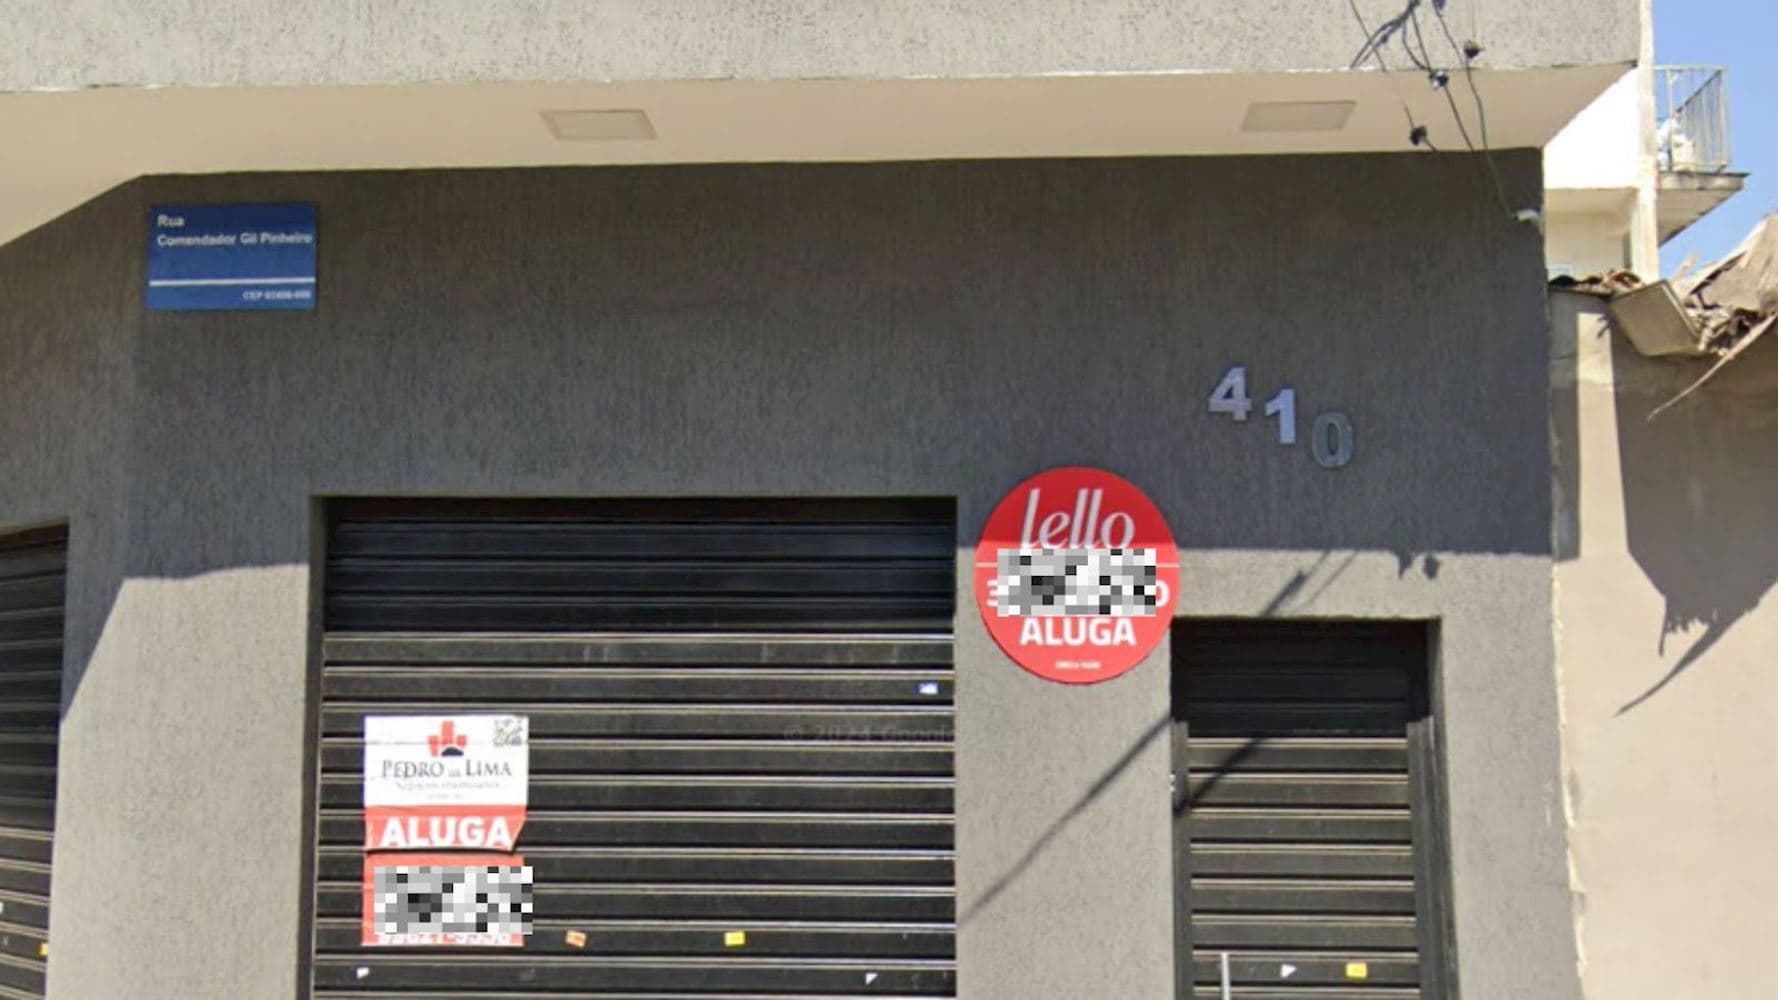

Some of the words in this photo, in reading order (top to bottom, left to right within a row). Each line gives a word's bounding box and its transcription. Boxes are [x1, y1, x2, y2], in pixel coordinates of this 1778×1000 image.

[157, 214, 185, 227] Rua
[157, 234, 237, 247] Comendador
[239, 232, 257, 245] Gil
[260, 231, 313, 244] Pinheiro
[242, 291, 263, 301] CEP
[1208, 367, 1354, 468] 410
[1019, 488, 1136, 550] lello
[1019, 617, 1137, 646] ALUGA
[381, 758, 444, 778] PEDRO
[465, 758, 513, 777] LIMA
[379, 816, 514, 850] ALUGA
